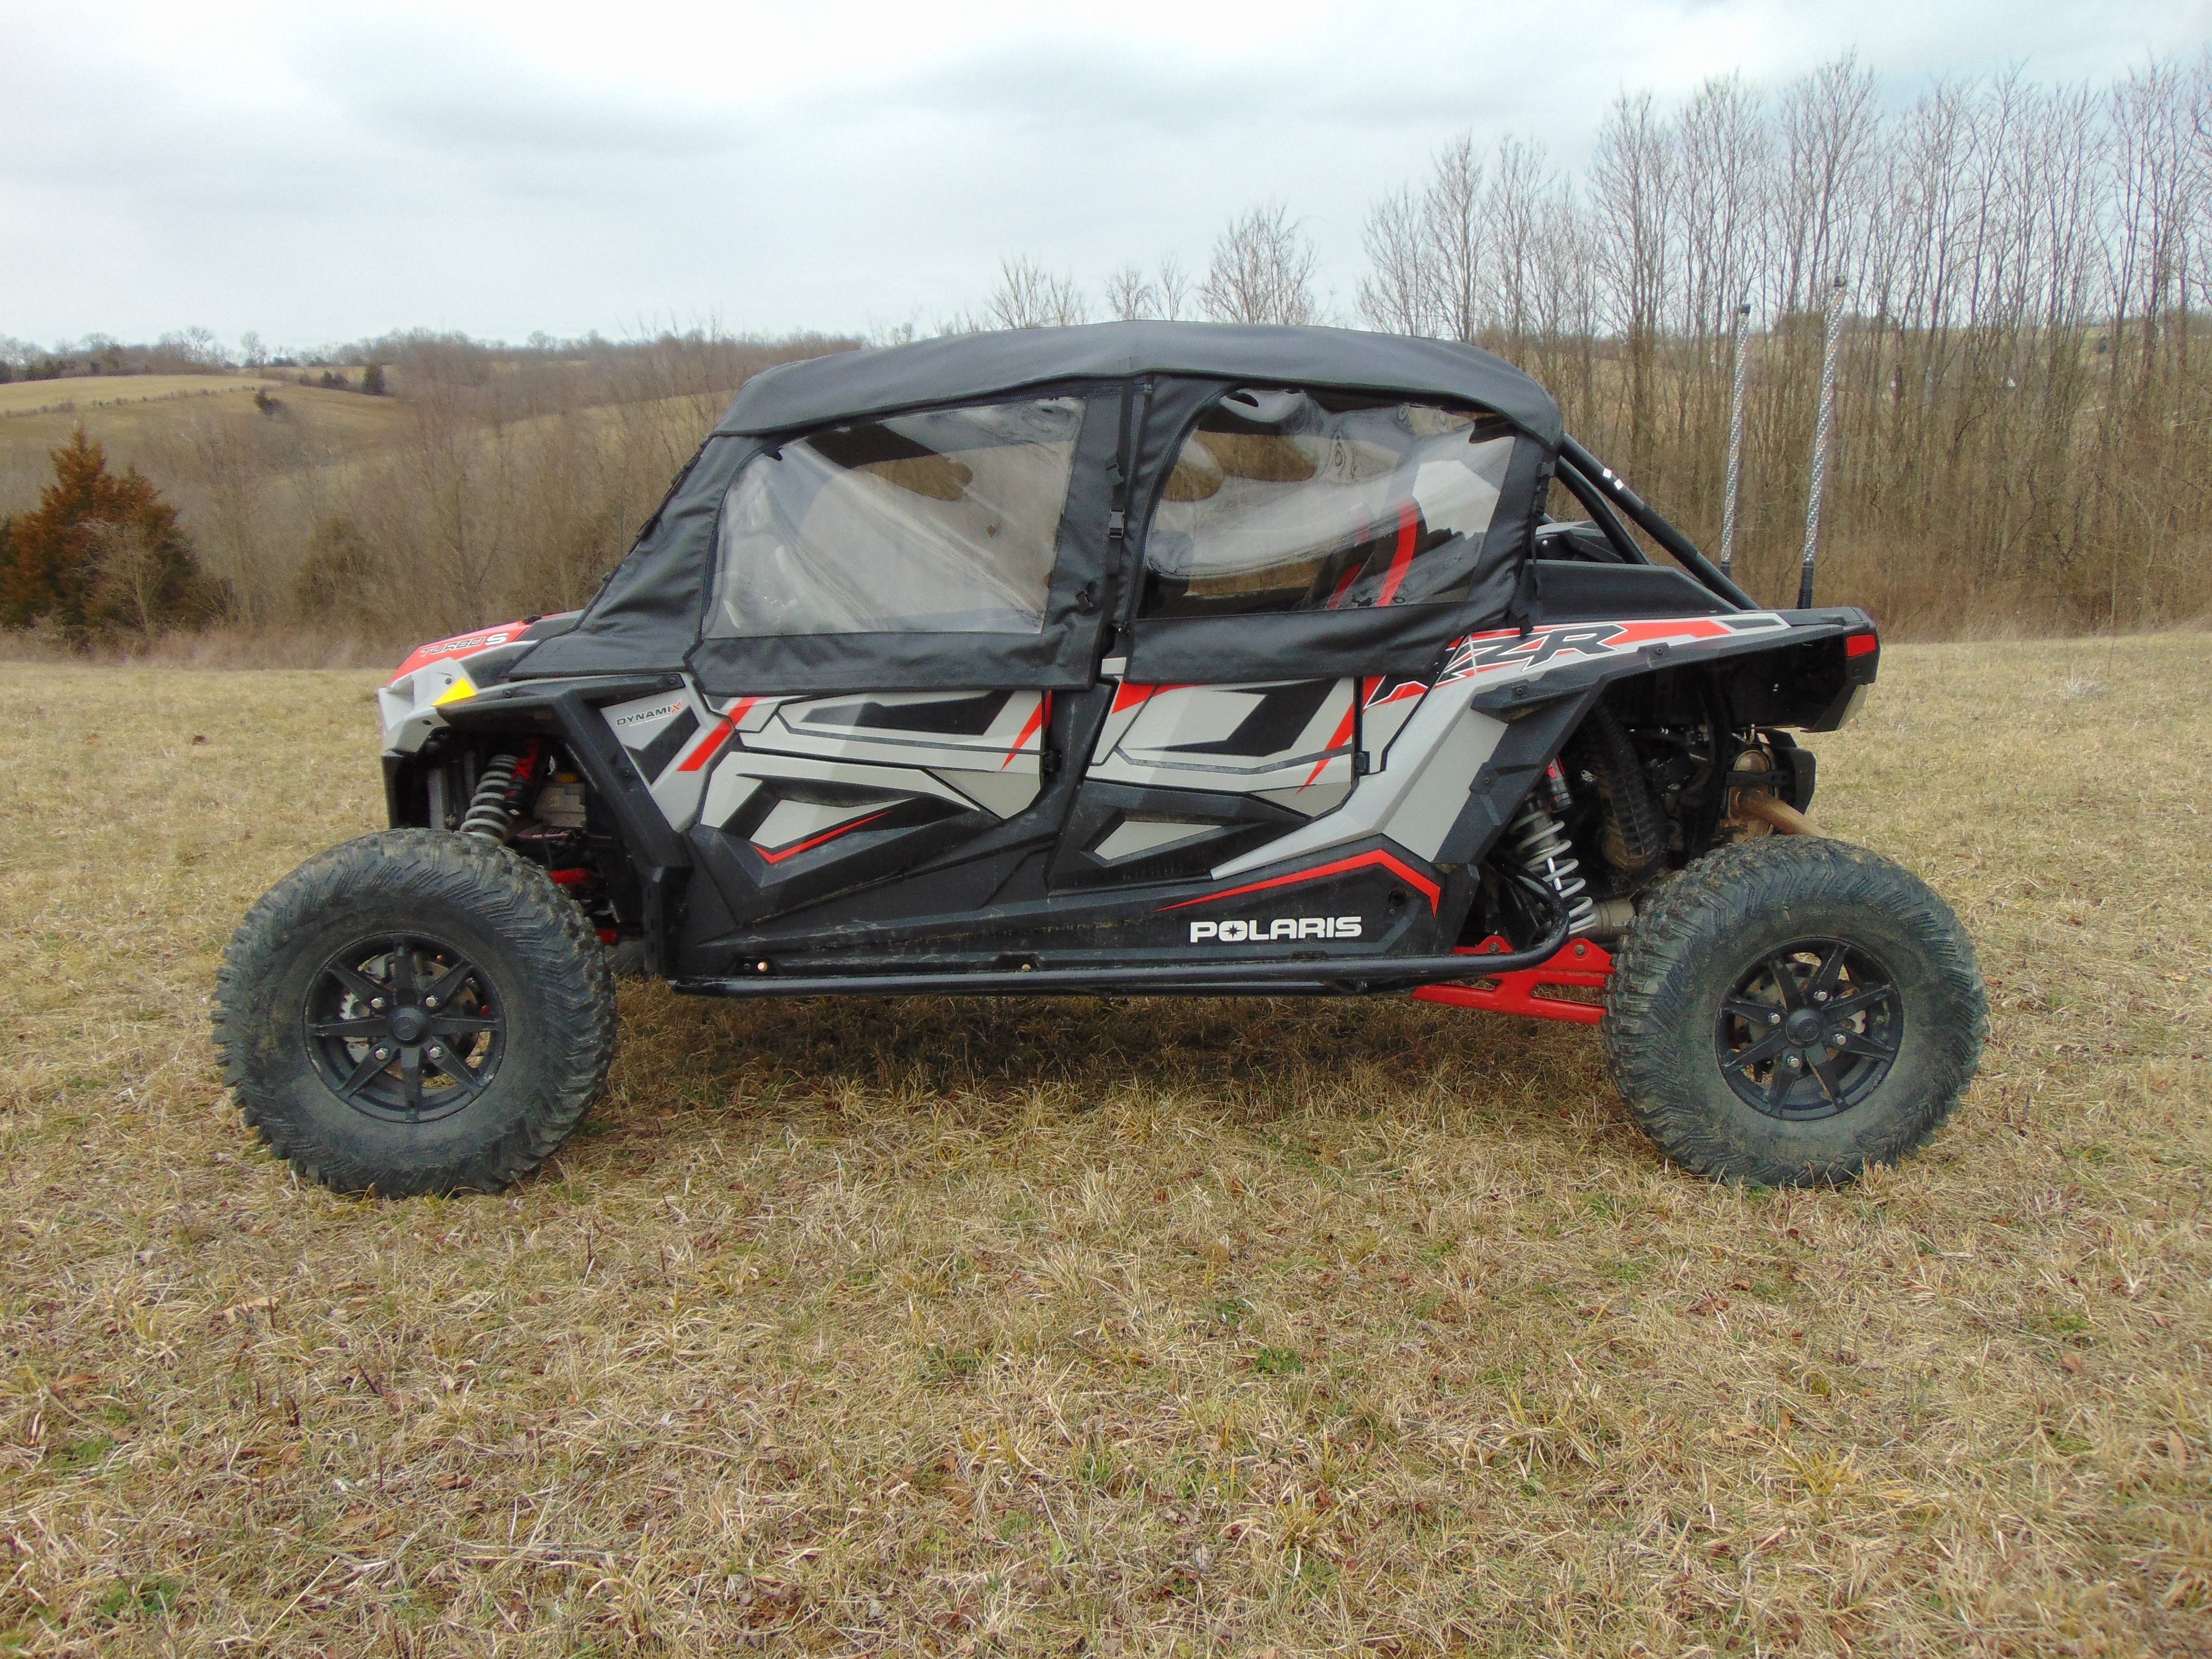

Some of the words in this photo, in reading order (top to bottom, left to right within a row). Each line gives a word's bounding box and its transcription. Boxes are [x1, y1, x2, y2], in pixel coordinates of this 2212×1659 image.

[420, 636, 486, 657] TURBO
[484, 632, 509, 646] S
[616, 699, 682, 726] DYNAMIX
[1190, 916, 1362, 943] POLARIS
